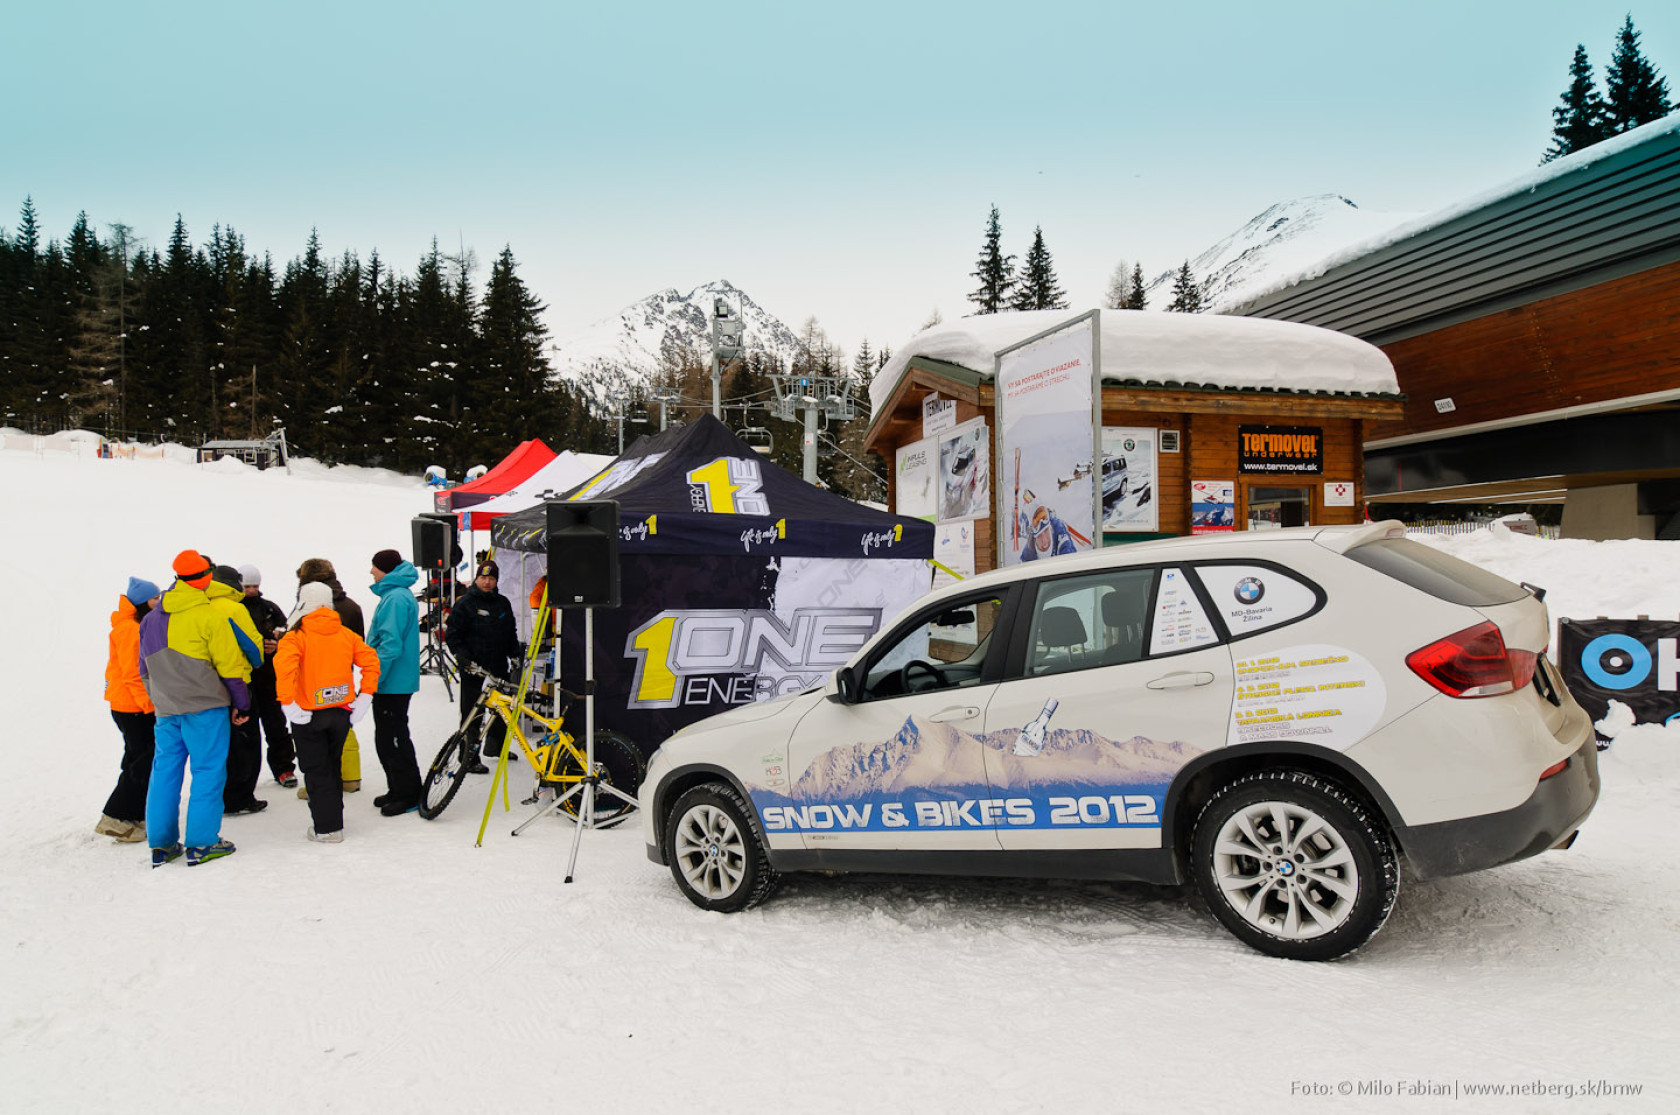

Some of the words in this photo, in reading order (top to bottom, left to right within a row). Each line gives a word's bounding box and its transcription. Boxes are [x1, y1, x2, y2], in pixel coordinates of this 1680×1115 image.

[1243, 450, 1317, 458] underwear
[1244, 462, 1318, 471] www.termovel.sk
[762, 802, 873, 830] SNOW
[881, 802, 911, 828] &
[914, 798, 1036, 828] BIKES
[1049, 794, 1161, 825] 2012
